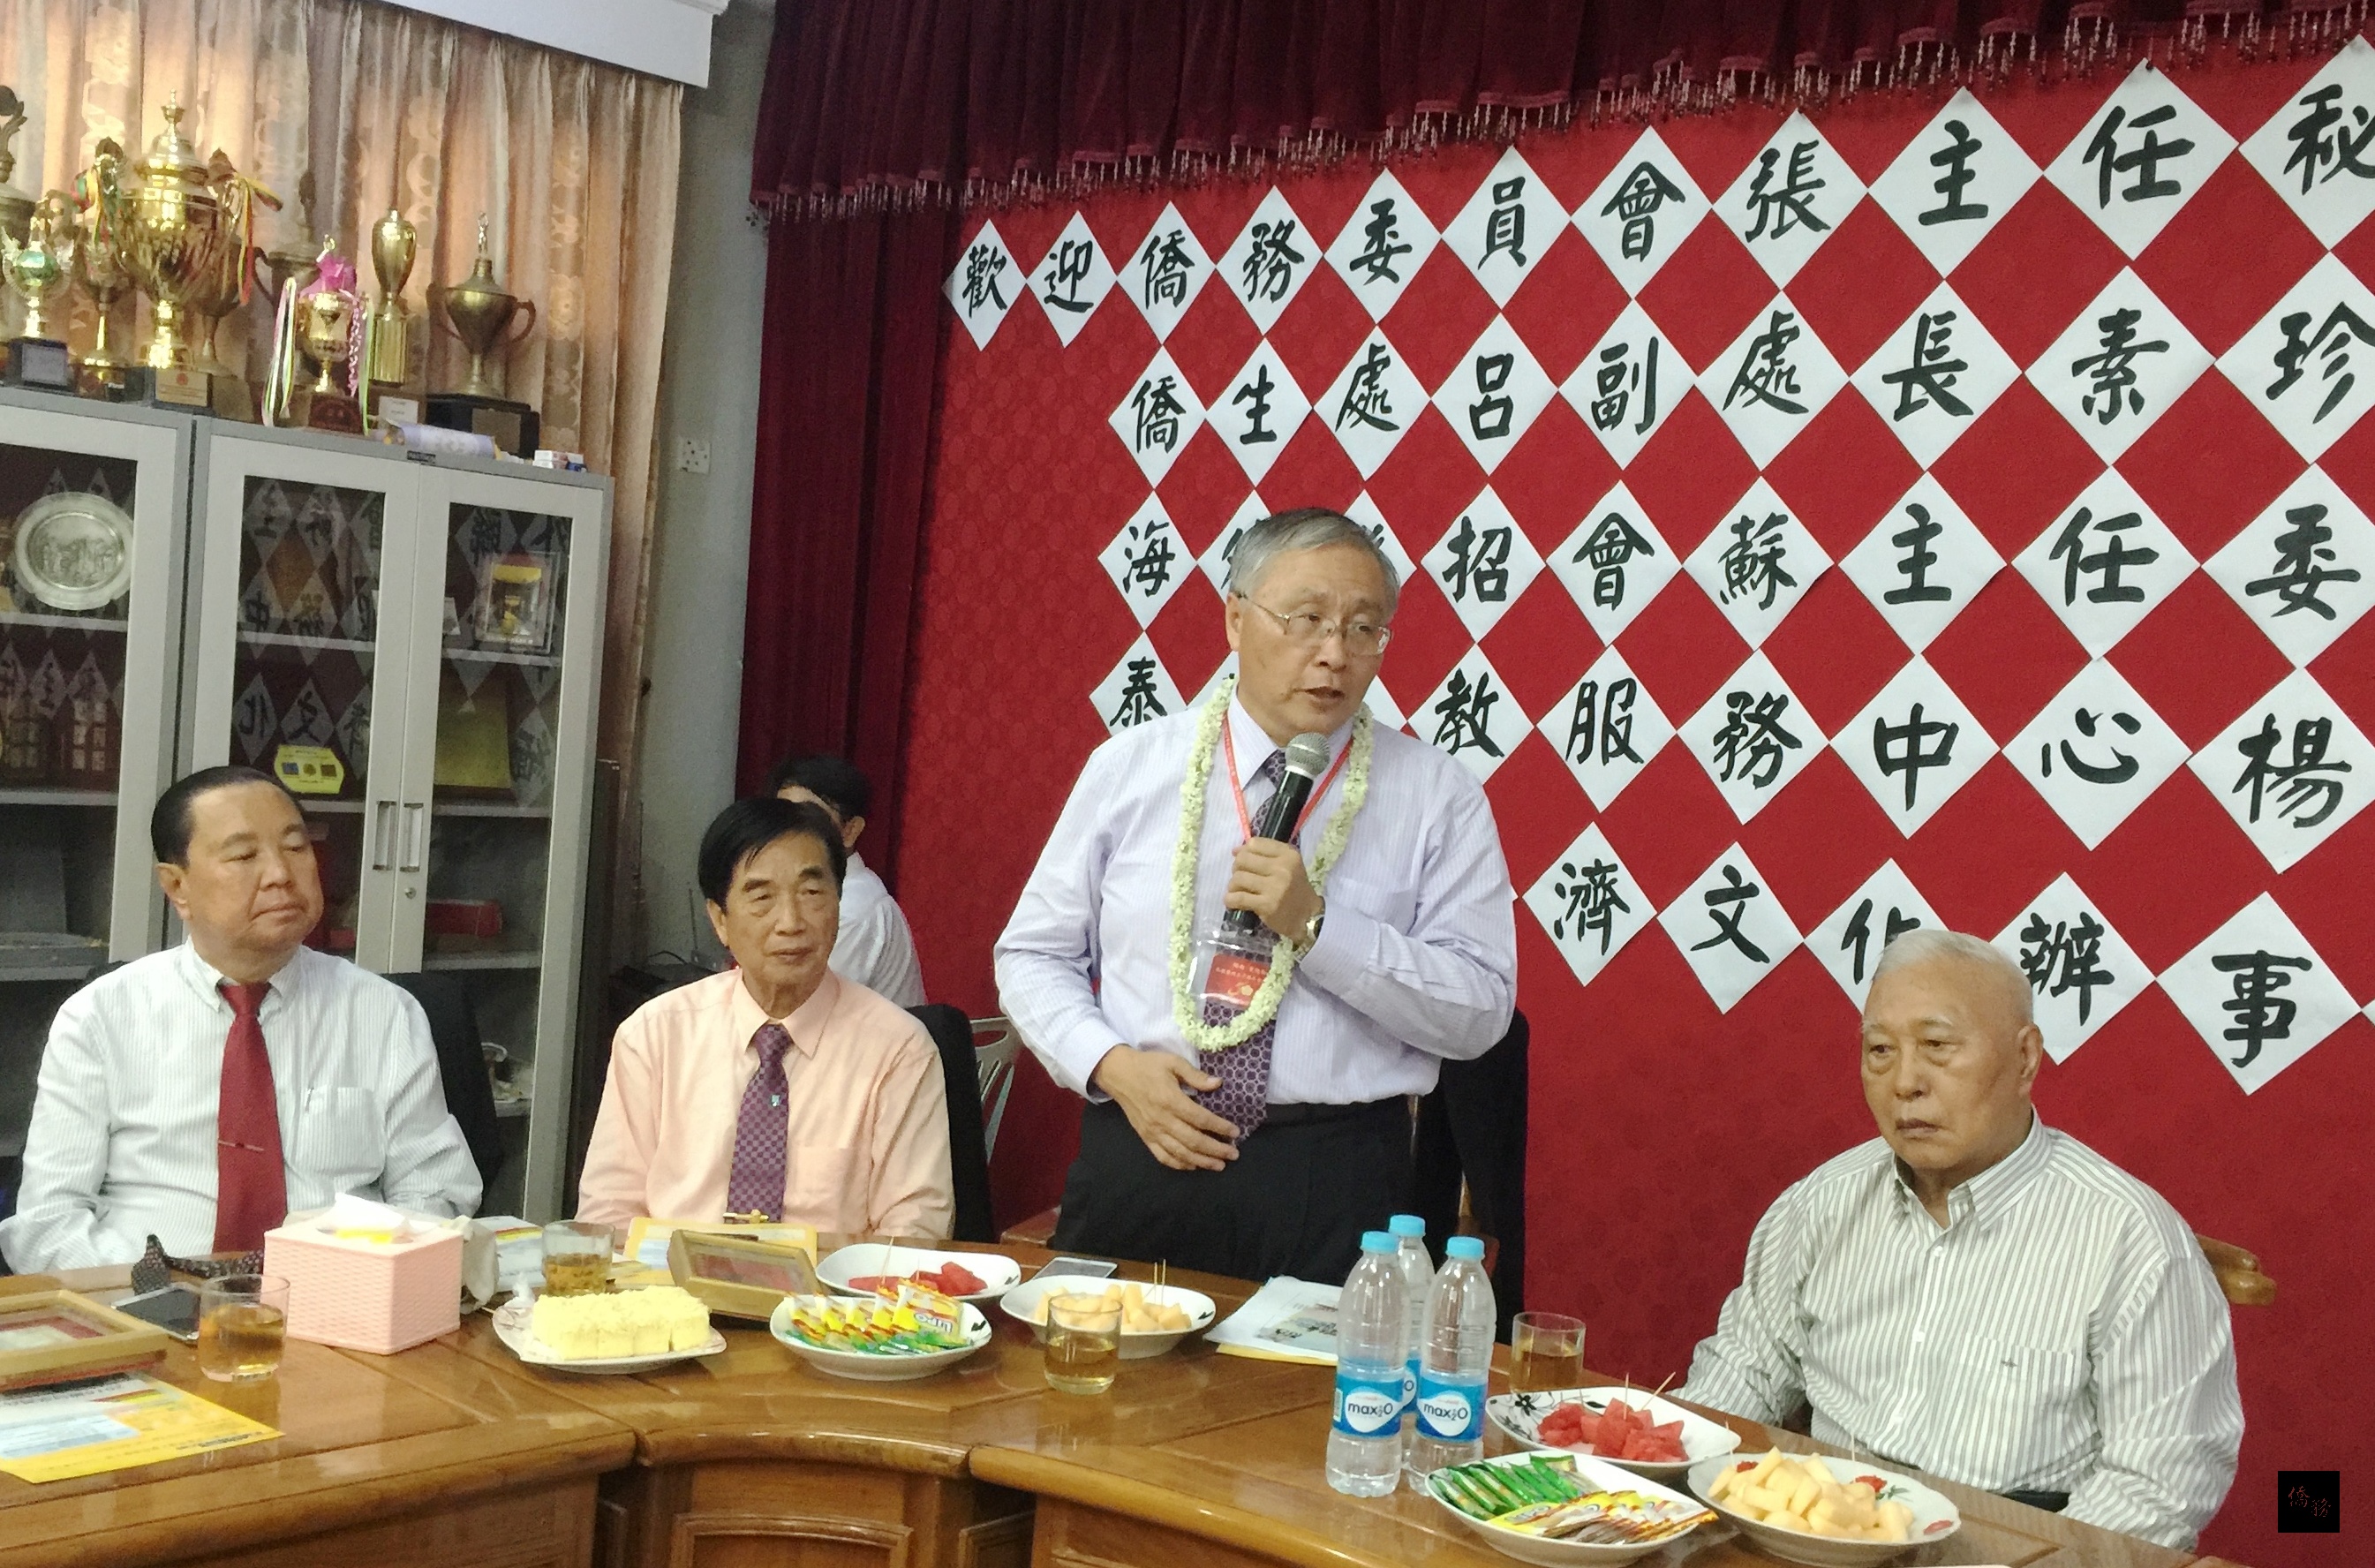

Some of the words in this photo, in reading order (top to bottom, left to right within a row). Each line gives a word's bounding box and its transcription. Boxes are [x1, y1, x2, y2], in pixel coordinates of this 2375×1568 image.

[1130, 301, 2375, 454] 僑生處呂副處長素珍
[1122, 502, 2361, 620] 海招會蘇主任委
[1110, 656, 2353, 827] 泰教服務中心楊
